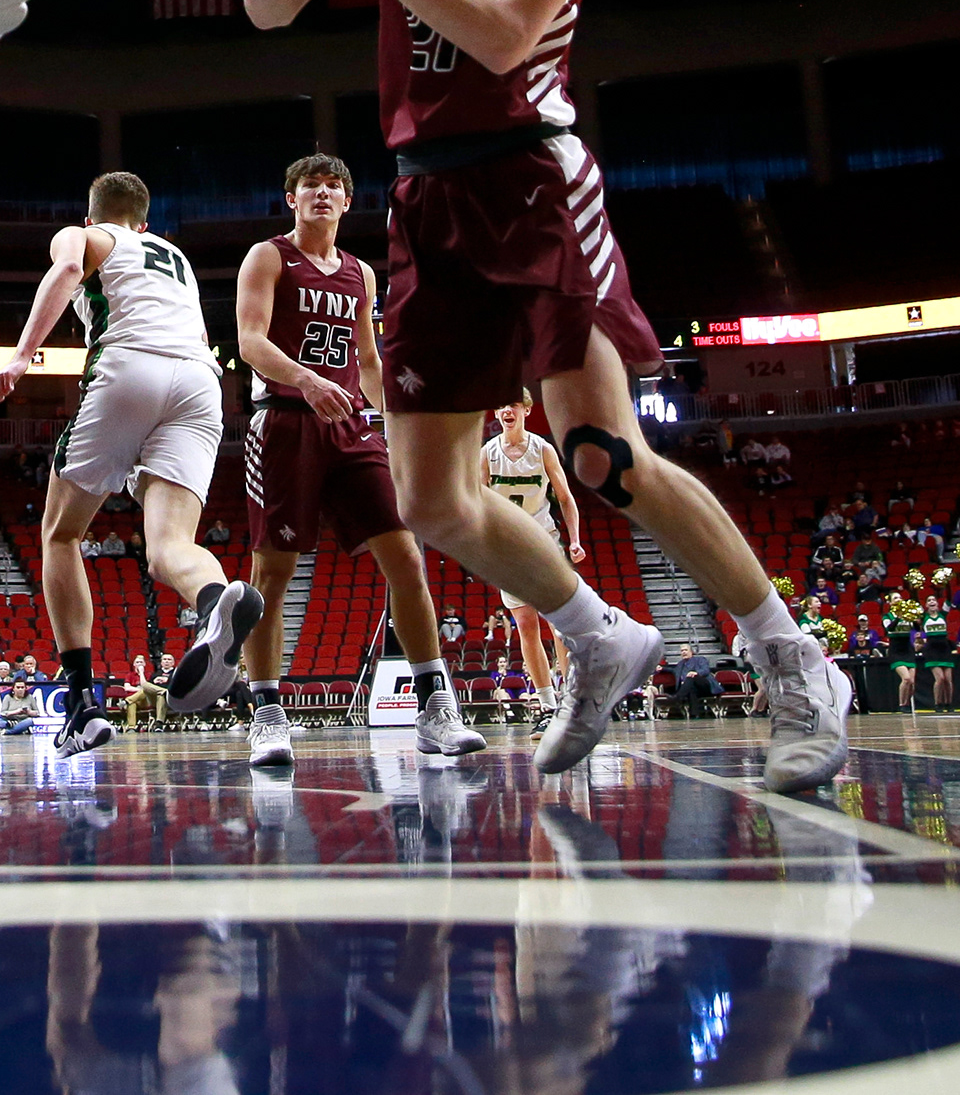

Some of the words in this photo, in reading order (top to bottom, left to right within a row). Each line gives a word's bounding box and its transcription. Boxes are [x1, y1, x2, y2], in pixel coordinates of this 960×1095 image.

[140, 241, 187, 287] 21
[298, 287, 359, 321] LYNX
[690, 320, 701, 334] 3
[709, 321, 740, 333] FOULS
[298, 321, 353, 369] 25
[673, 335, 683, 347] 4
[693, 336, 715, 346] TIME
[715, 334, 740, 345] OUTS
[226, 358, 236, 371] 4
[745, 360, 787, 378] 124
